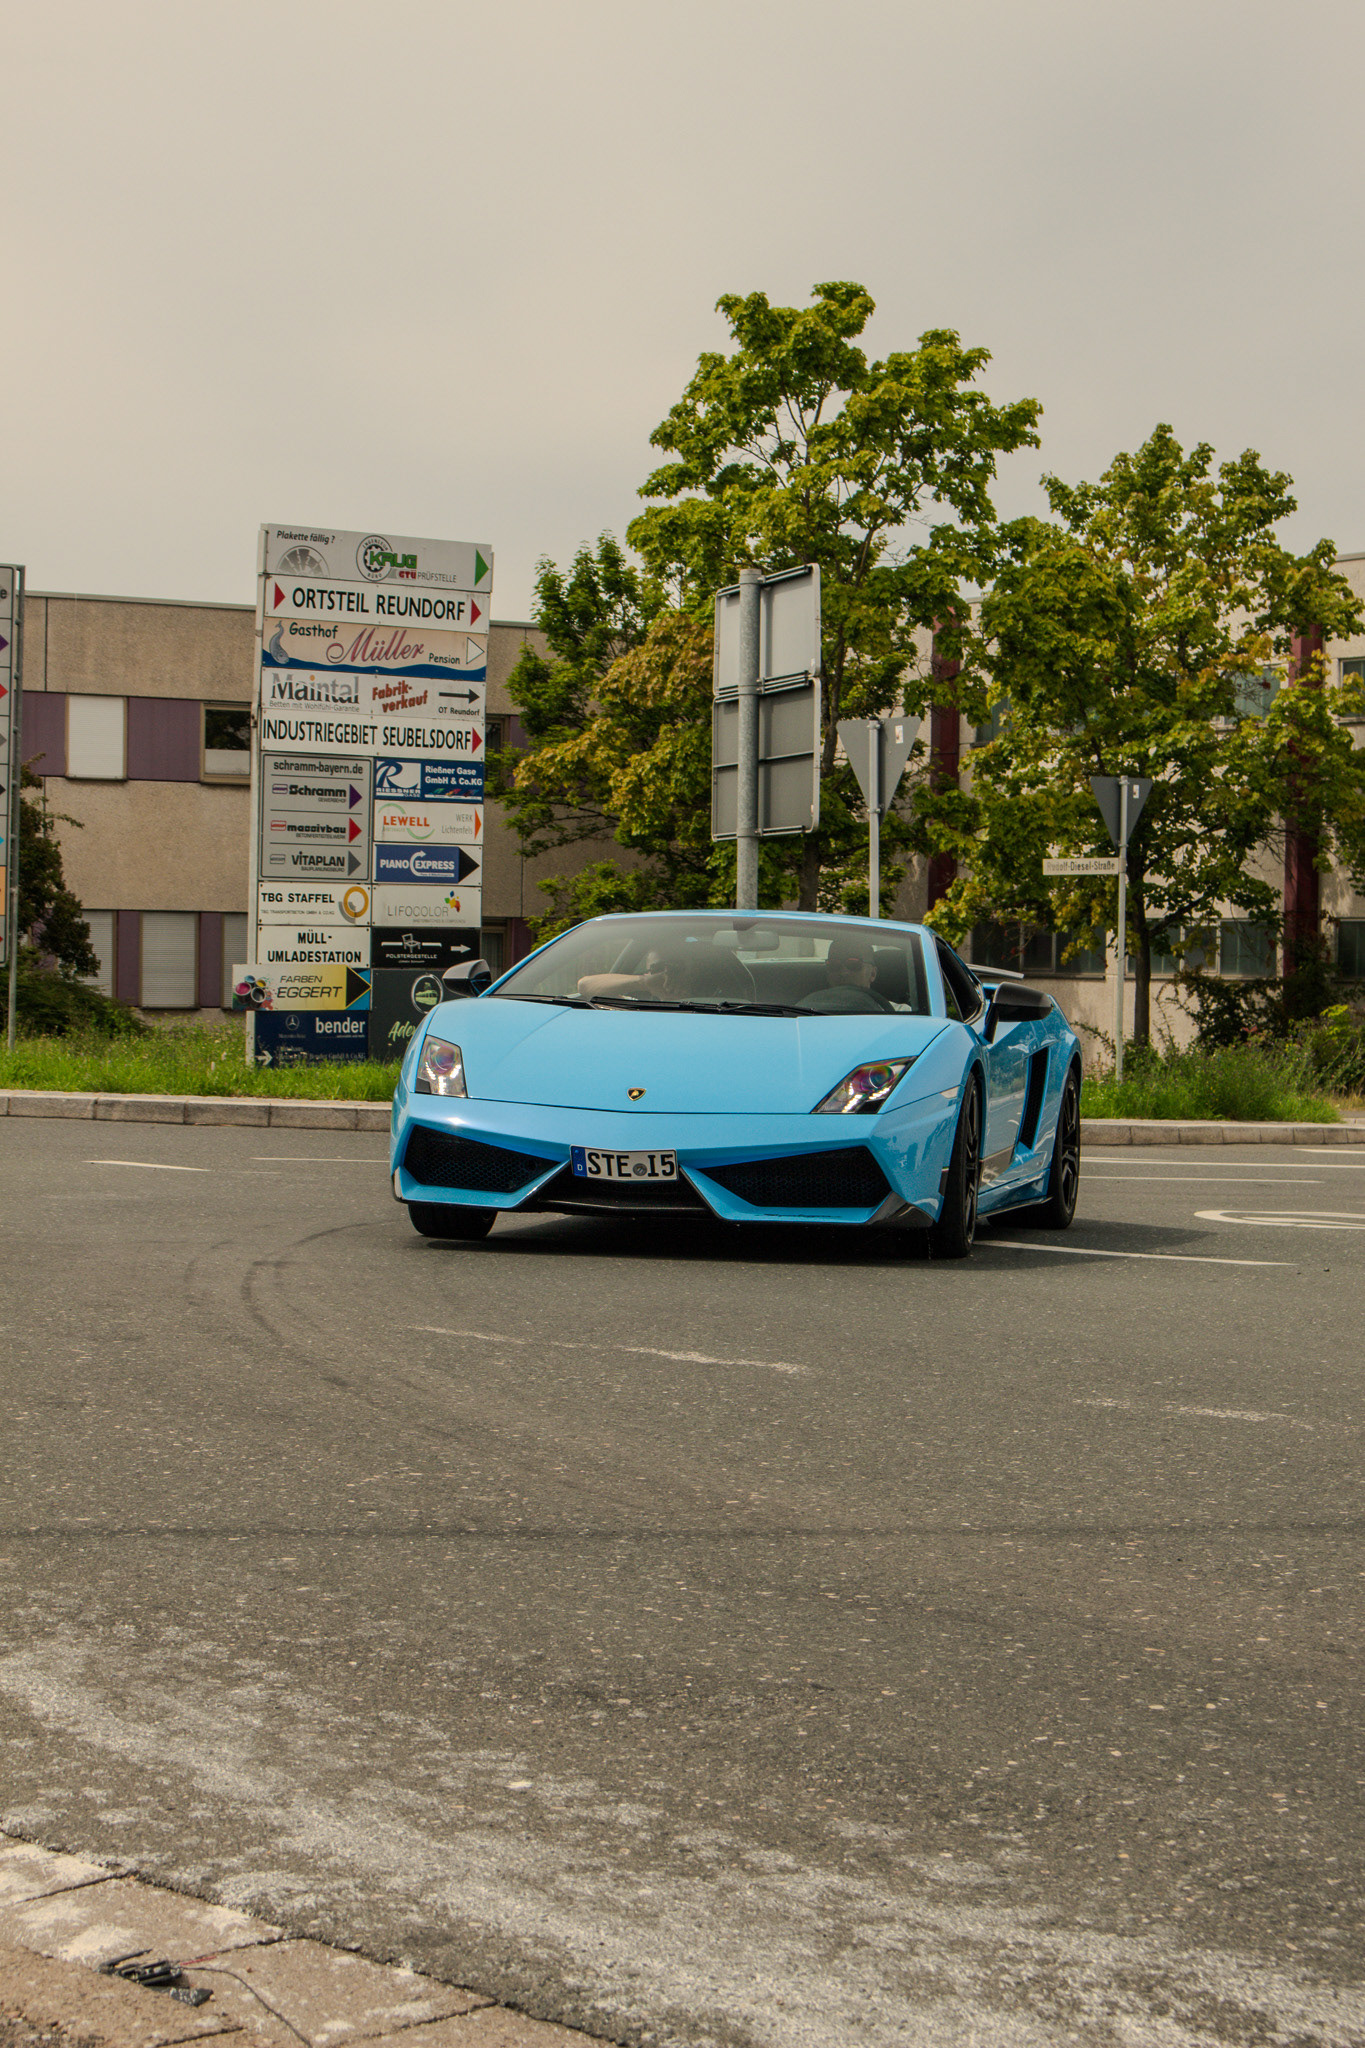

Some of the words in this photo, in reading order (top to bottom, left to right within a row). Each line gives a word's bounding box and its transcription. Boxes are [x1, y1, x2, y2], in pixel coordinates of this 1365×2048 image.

[277, 530, 308, 541] Plakette
[310, 534, 330, 545] fällig
[331, 536, 336, 544] ?
[370, 551, 418, 569] KRUG
[398, 570, 416, 580] GTÜ
[418, 572, 456, 582] PRÜFSTELLE
[292, 587, 369, 613] ORTSTEIL
[376, 594, 466, 620] REUNDORF
[289, 622, 338, 639] Gasthof
[326, 627, 424, 664] Müller
[428, 652, 460, 664] Pension
[270, 673, 360, 704] Maintal
[372, 680, 413, 700] Fabrik-
[270, 700, 290, 708] Betten
[382, 690, 428, 713] verkauf
[438, 706, 448, 714] OT
[450, 707, 480, 716] Reundorf
[263, 719, 378, 744] INDUSTRIEGEBIET
[382, 726, 471, 750] SEUBELSDORF
[273, 760, 364, 776] schramm-bayern.de
[425, 765, 456, 774] Rießner
[456, 766, 476, 776] Gase
[424, 776, 448, 784] GmbH
[450, 777, 456, 785] &
[458, 778, 482, 786] Co.KG
[288, 784, 346, 798] Schramm
[383, 816, 430, 827] LEWELL
[456, 814, 473, 822] WERK
[287, 824, 346, 834] massivbau
[442, 825, 473, 834] Lichtenfels
[380, 858, 410, 869] PIANO
[414, 860, 455, 870] EXPRESS
[1046, 860, 1116, 872] Rudolf-Diesel-Straße
[261, 892, 283, 902] TBG
[287, 893, 335, 904] STAFFEL
[388, 905, 449, 917] LIFOCOLOR
[297, 928, 332, 944] MÜLL-
[267, 950, 362, 963] UMLADESTATION
[280, 976, 323, 984] FARBEN
[276, 986, 342, 998] EGGERT
[316, 1016, 366, 1034] bender
[587, 1152, 632, 1178] STE
